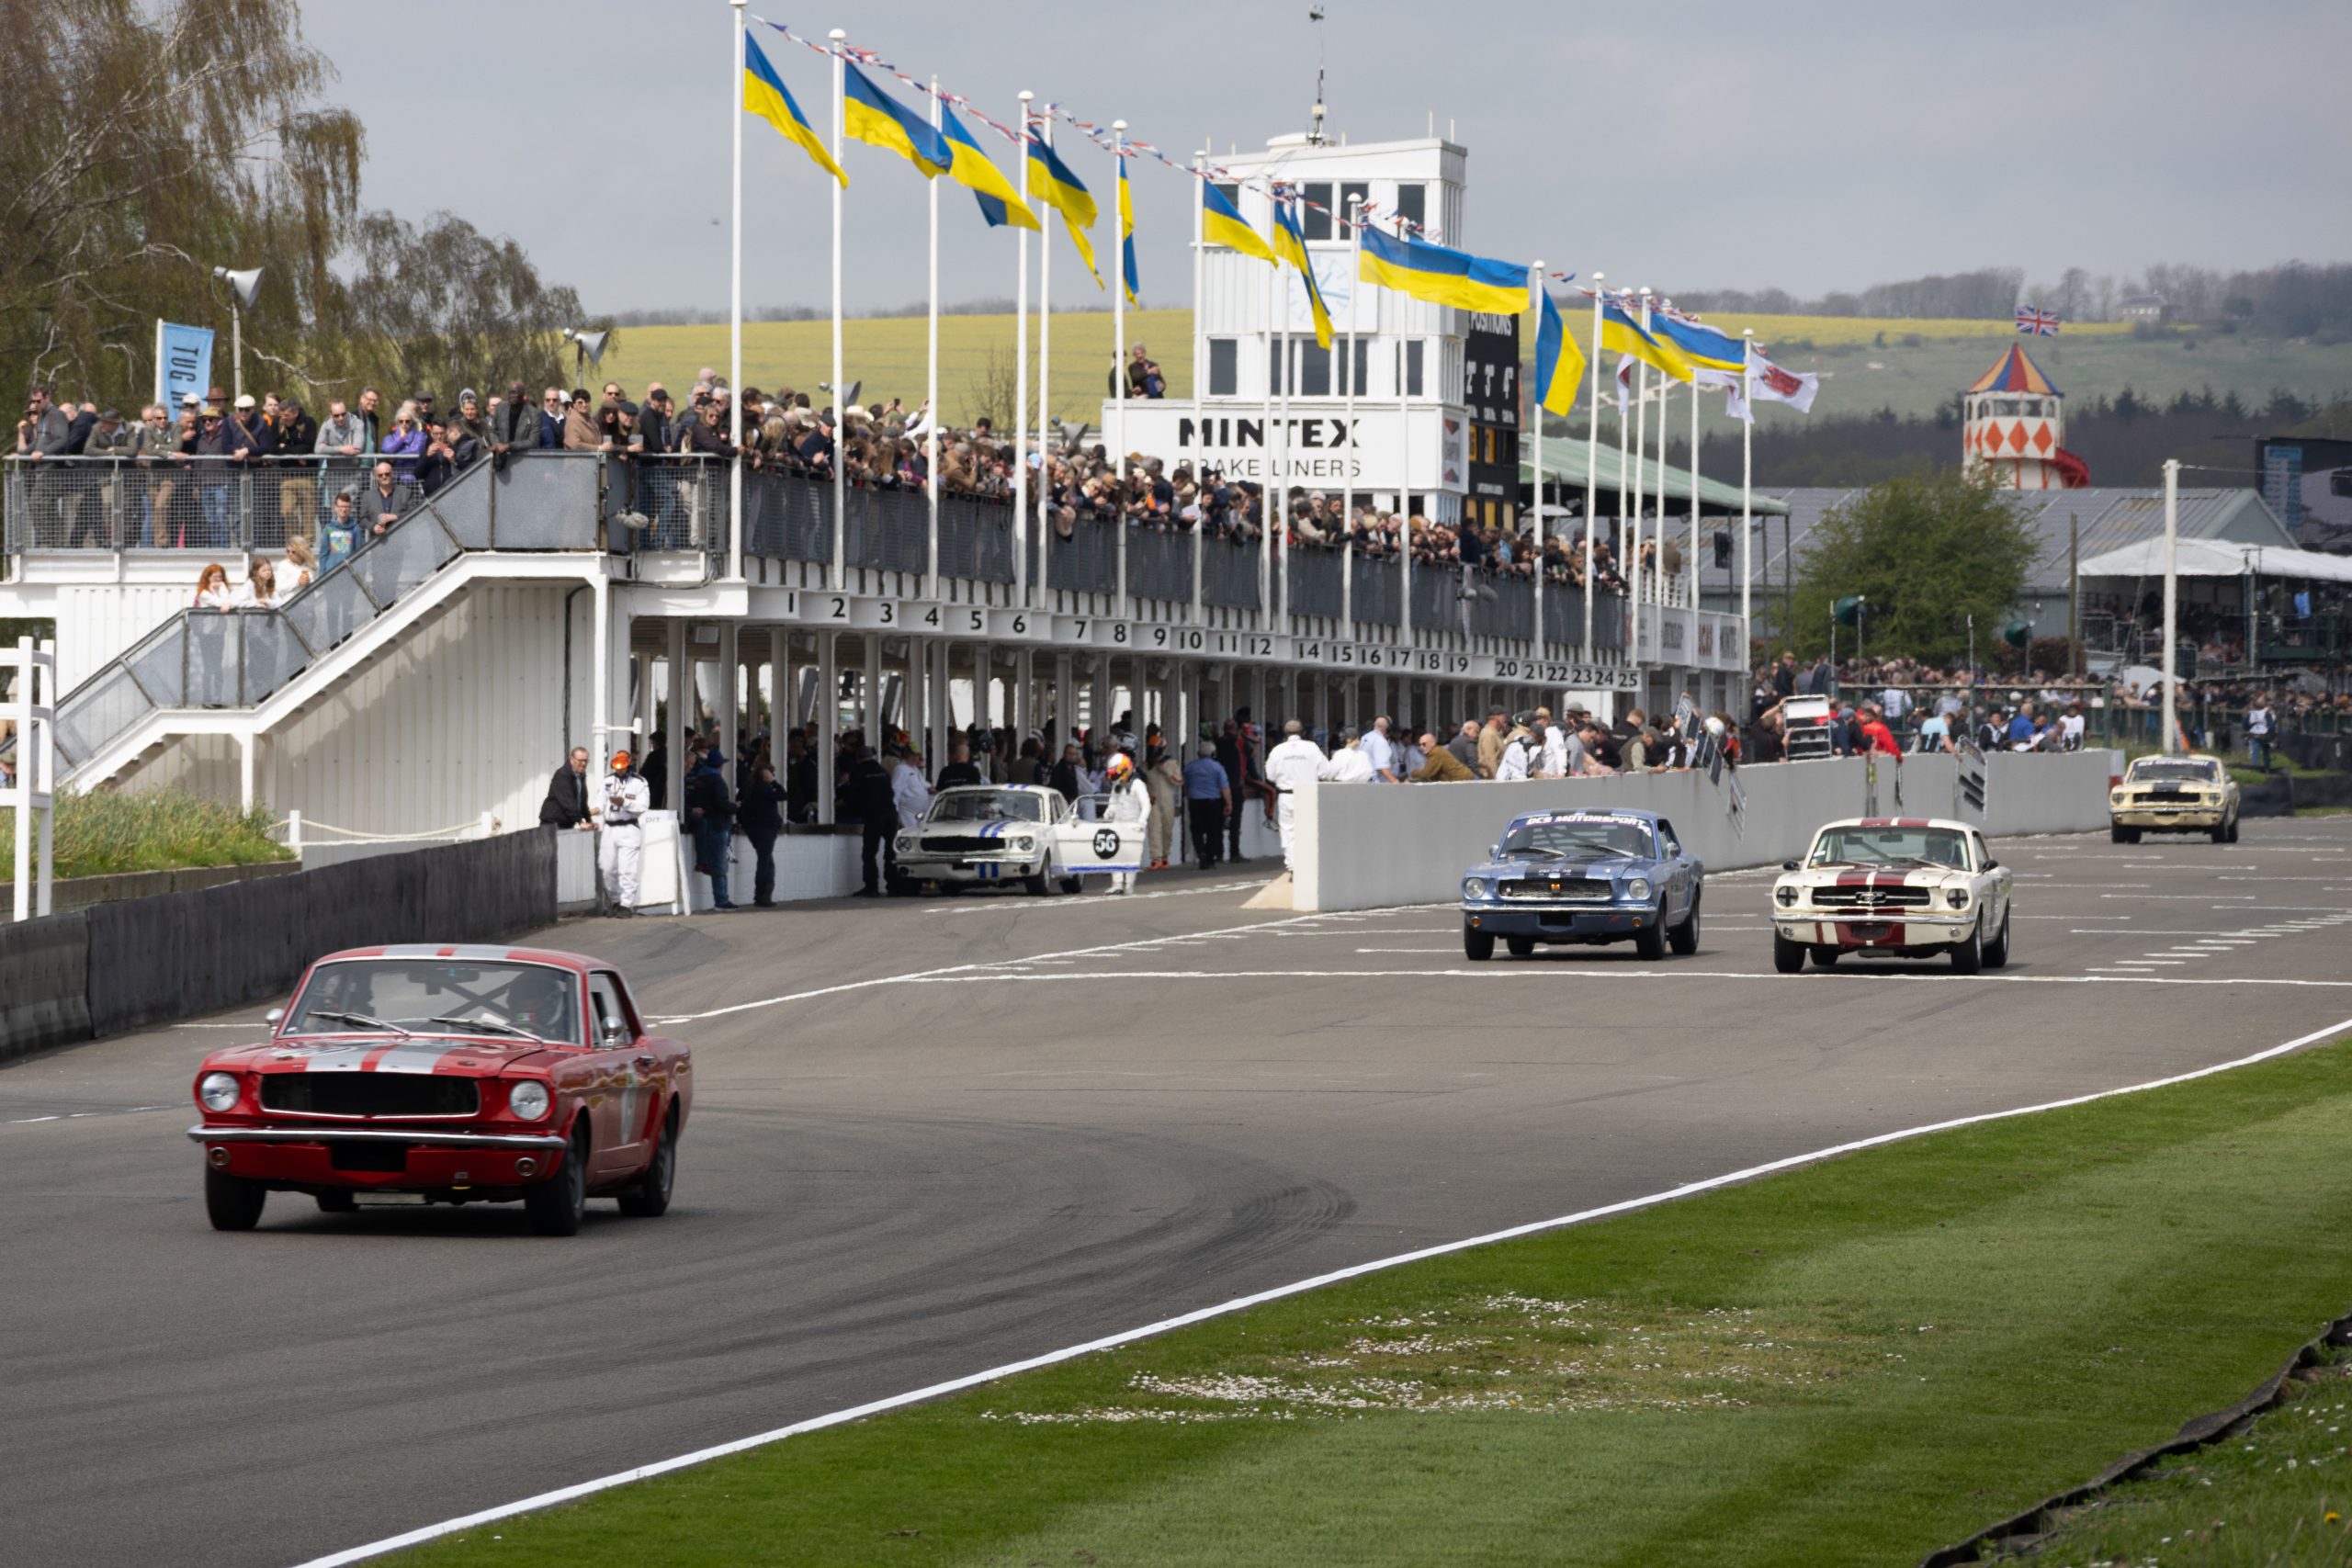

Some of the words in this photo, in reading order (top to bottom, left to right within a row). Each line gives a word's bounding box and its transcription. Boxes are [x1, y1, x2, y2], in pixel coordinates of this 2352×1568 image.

[169, 346, 199, 382] TUG
[1272, 459, 1361, 477] LINERS
[788, 592, 794, 613] 1
[831, 598, 846, 617] 2
[880, 603, 893, 623] 3
[924, 607, 939, 626] 4
[970, 611, 982, 630] 5
[1012, 615, 1025, 634] 6
[1075, 621, 1087, 638] 7
[1114, 624, 1126, 643] 8
[1154, 628, 1166, 646] 9
[1180, 631, 1202, 649] 10
[1219, 635, 1237, 652] 11
[1250, 637, 1272, 655] 12
[1298, 643, 1319, 659] 14
[1333, 646, 1351, 662] 15
[1362, 649, 1381, 665] 16
[1391, 650, 1410, 666] 17
[1420, 653, 1440, 670] 18
[1450, 657, 1468, 672] 19
[1496, 661, 1518, 677] 20
[1524, 664, 1544, 680] 21
[1547, 666, 1567, 682] 22
[1572, 669, 1593, 684] 23
[1595, 671, 1614, 685] 24
[1618, 673, 1638, 688] 25
[1555, 814, 1646, 826] MOTORSPORT
[1094, 832, 1116, 852] 56
